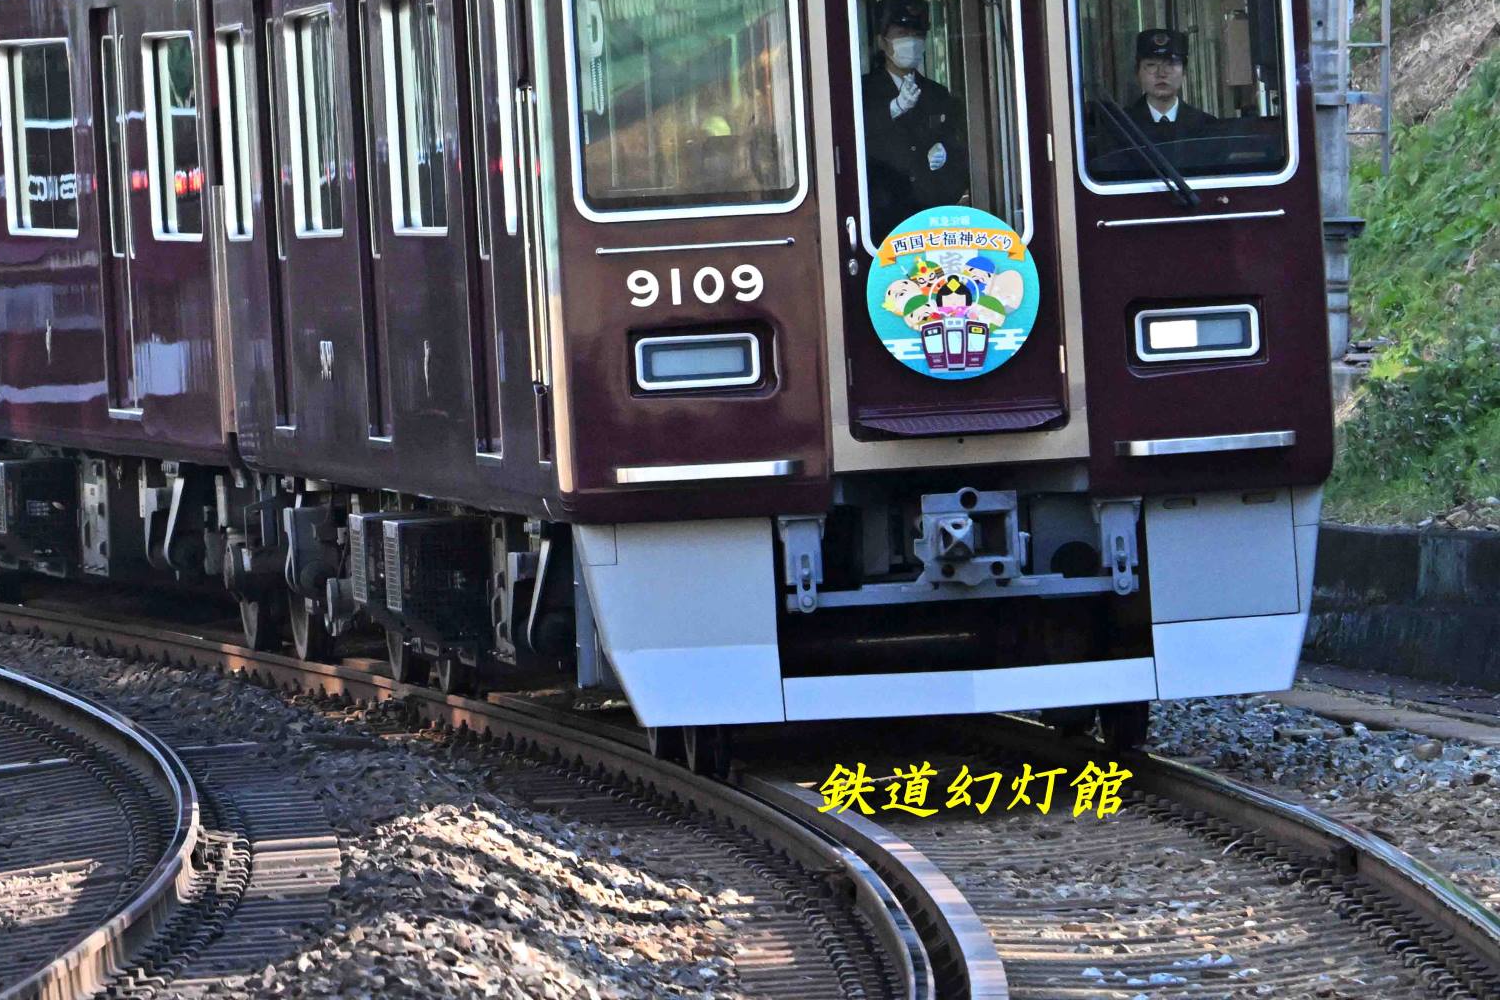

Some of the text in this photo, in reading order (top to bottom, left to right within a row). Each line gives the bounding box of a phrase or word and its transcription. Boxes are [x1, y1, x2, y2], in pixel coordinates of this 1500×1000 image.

[892, 231, 1014, 253] 西国七福神めぐり
[626, 264, 764, 307] 9109
